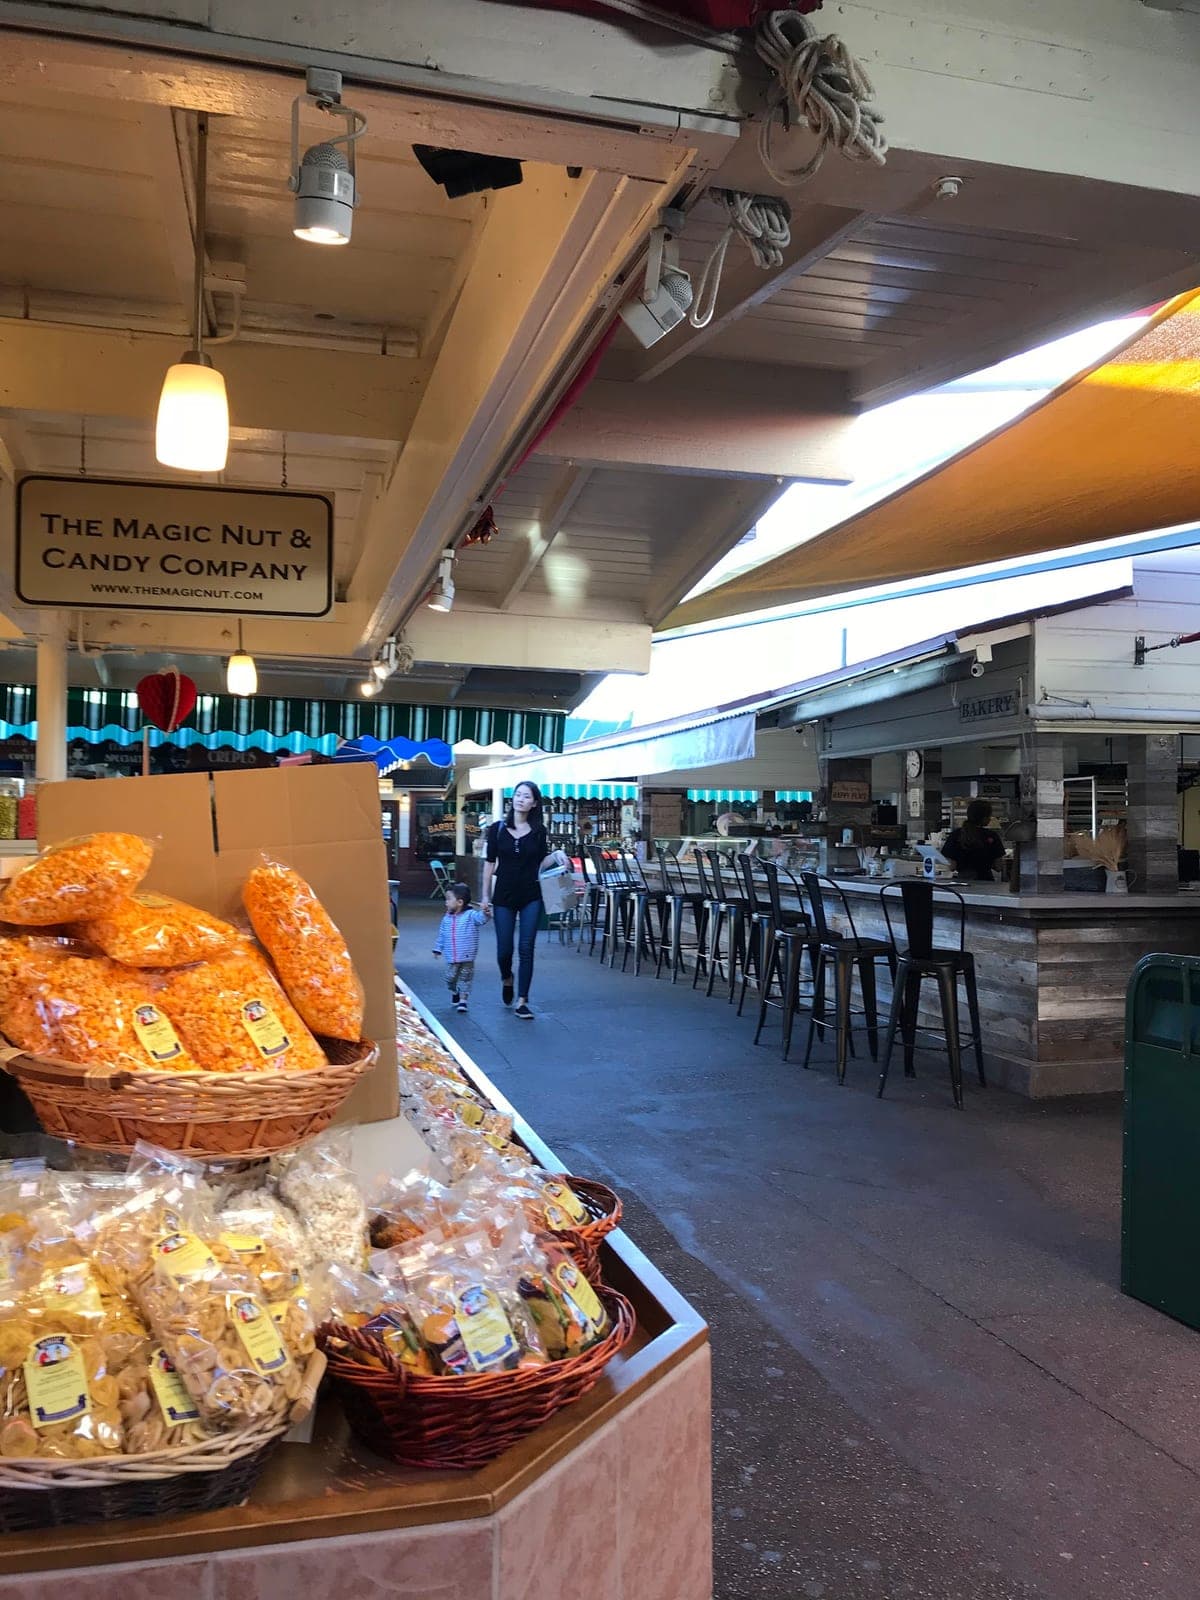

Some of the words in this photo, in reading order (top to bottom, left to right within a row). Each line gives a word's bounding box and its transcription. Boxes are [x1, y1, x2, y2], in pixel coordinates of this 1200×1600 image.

[40, 513, 103, 537] THE
[113, 518, 211, 543] MAGIC
[221, 524, 282, 547] NUT
[290, 529, 311, 549] &
[42, 547, 150, 573] CANDY
[160, 554, 307, 581] COMPANY
[961, 695, 1012, 718] BAKERY
